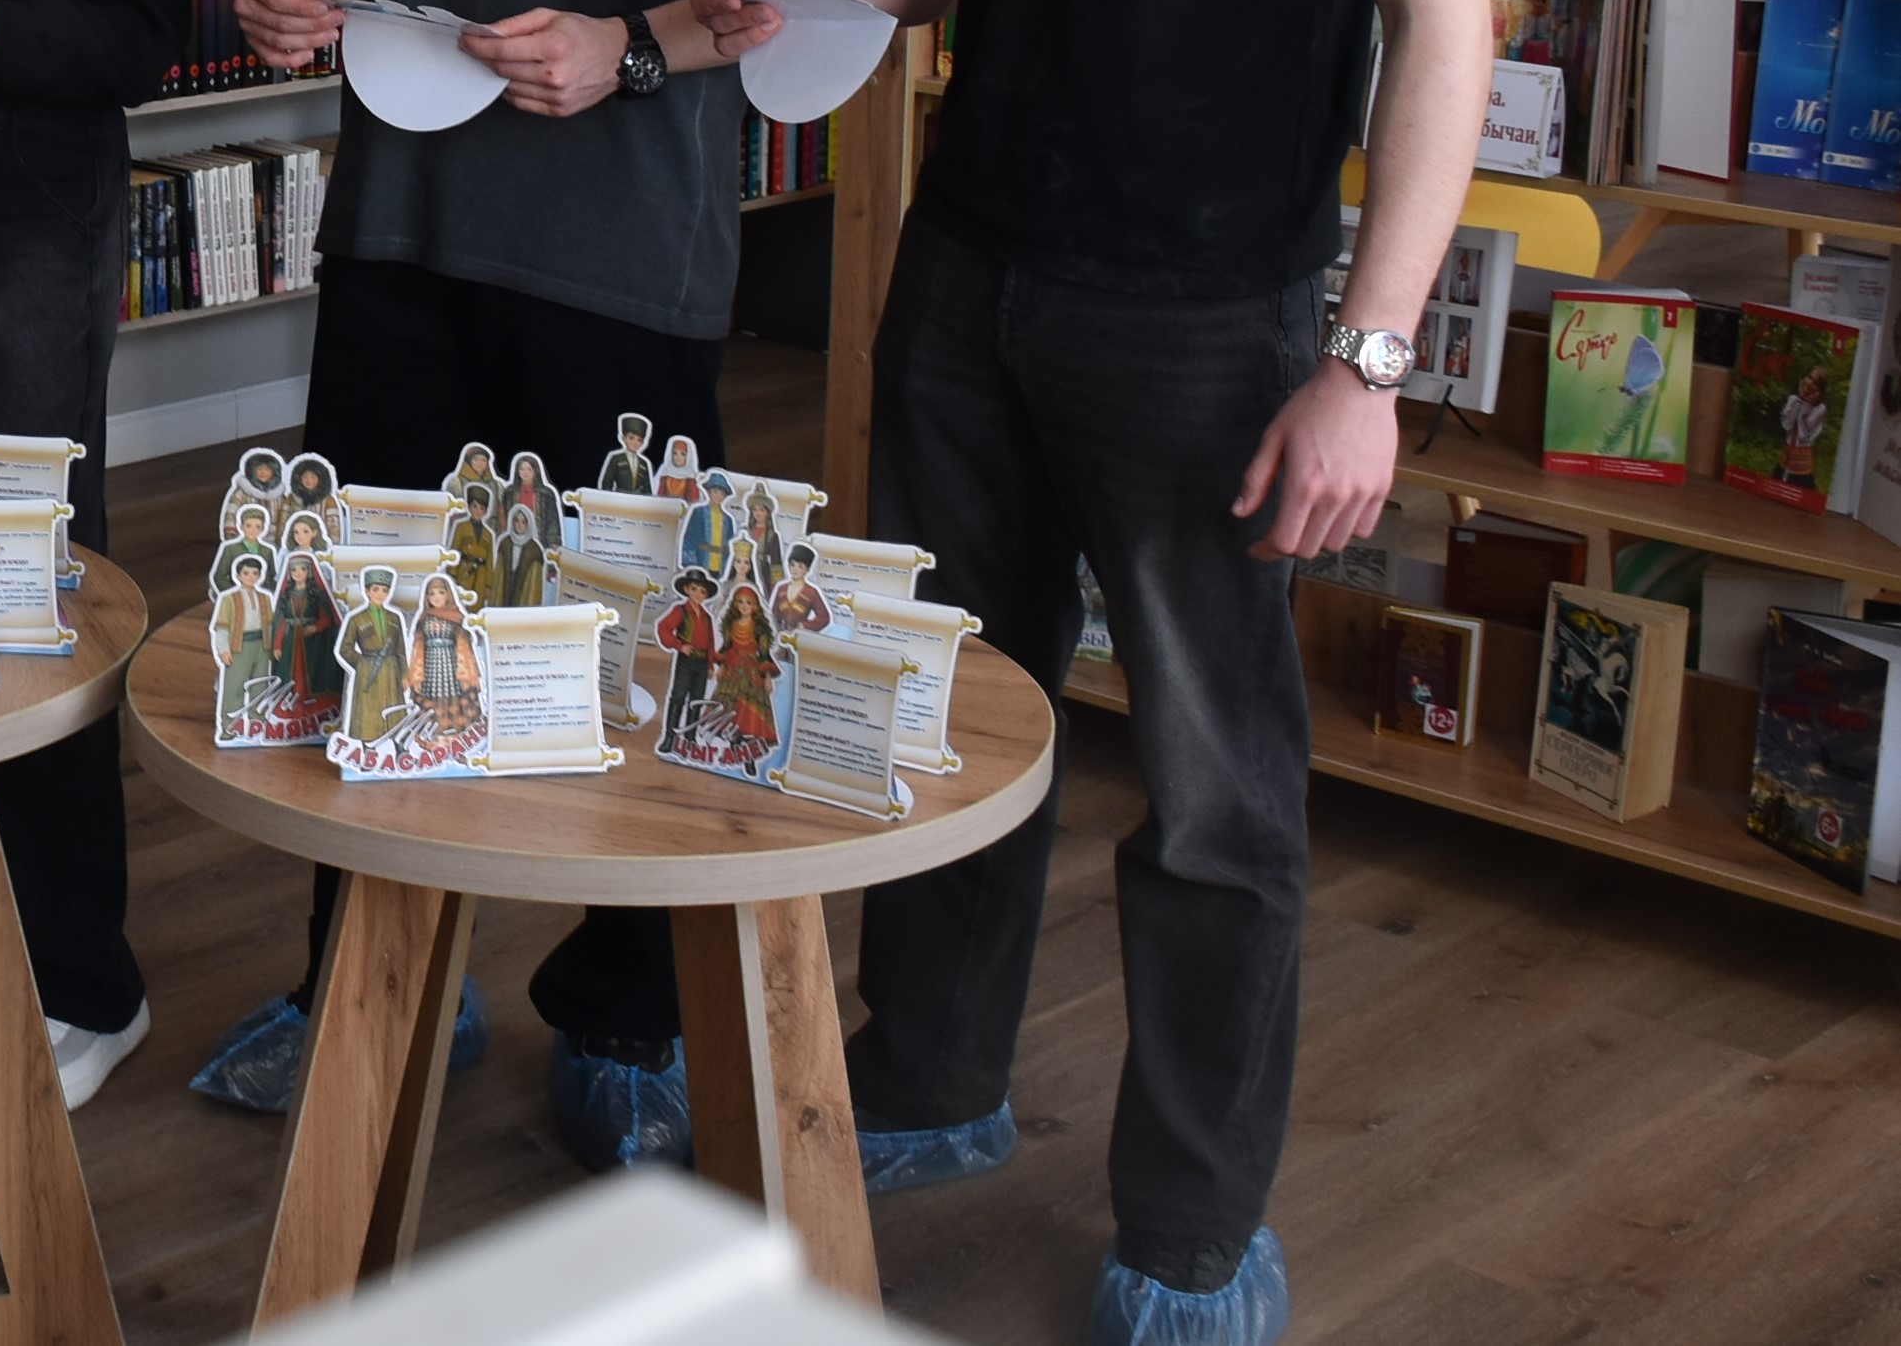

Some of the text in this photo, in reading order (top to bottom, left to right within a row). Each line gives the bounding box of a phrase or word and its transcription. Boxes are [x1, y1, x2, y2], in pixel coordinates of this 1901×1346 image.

[1480, 118, 1540, 146] бычаи.
[1427, 710, 1455, 733] 12+
[334, 717, 489, 771] ТАБАСАРАН
